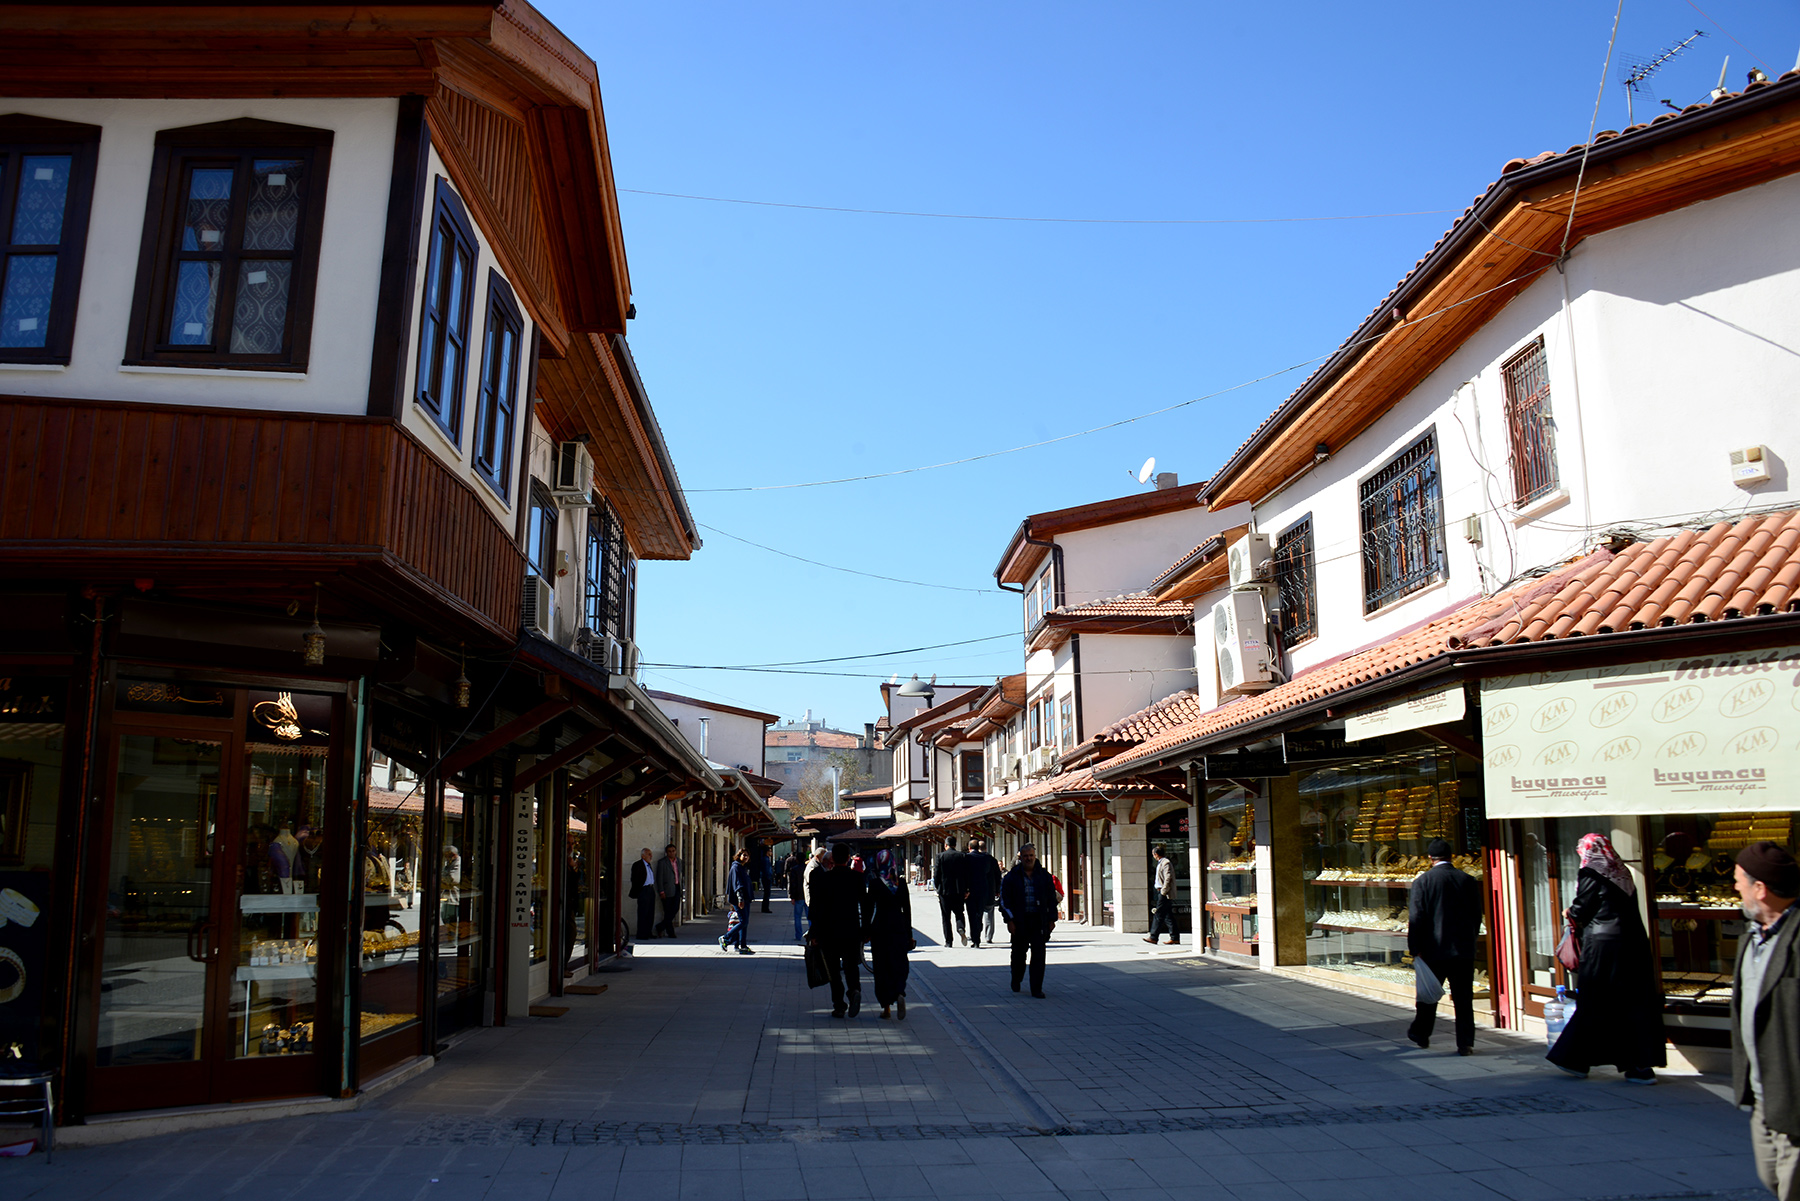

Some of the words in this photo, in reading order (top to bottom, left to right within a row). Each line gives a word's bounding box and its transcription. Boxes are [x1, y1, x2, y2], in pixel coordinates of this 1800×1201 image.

[1484, 706, 1512, 735] KM
[1539, 700, 1569, 730] KM
[1599, 694, 1629, 725] KM
[1662, 688, 1695, 720] KM
[1730, 681, 1766, 715] KM
[1488, 747, 1514, 769] KM
[1543, 743, 1572, 766] KM
[1603, 739, 1633, 763] KM
[1667, 734, 1698, 759] KM
[1735, 729, 1769, 755] KM
[1511, 775, 1606, 791] kuyumcu
[1653, 767, 1765, 784] kuyumcu
[1550, 789, 1600, 801] mustafa
[1700, 783, 1757, 796] mustafa
